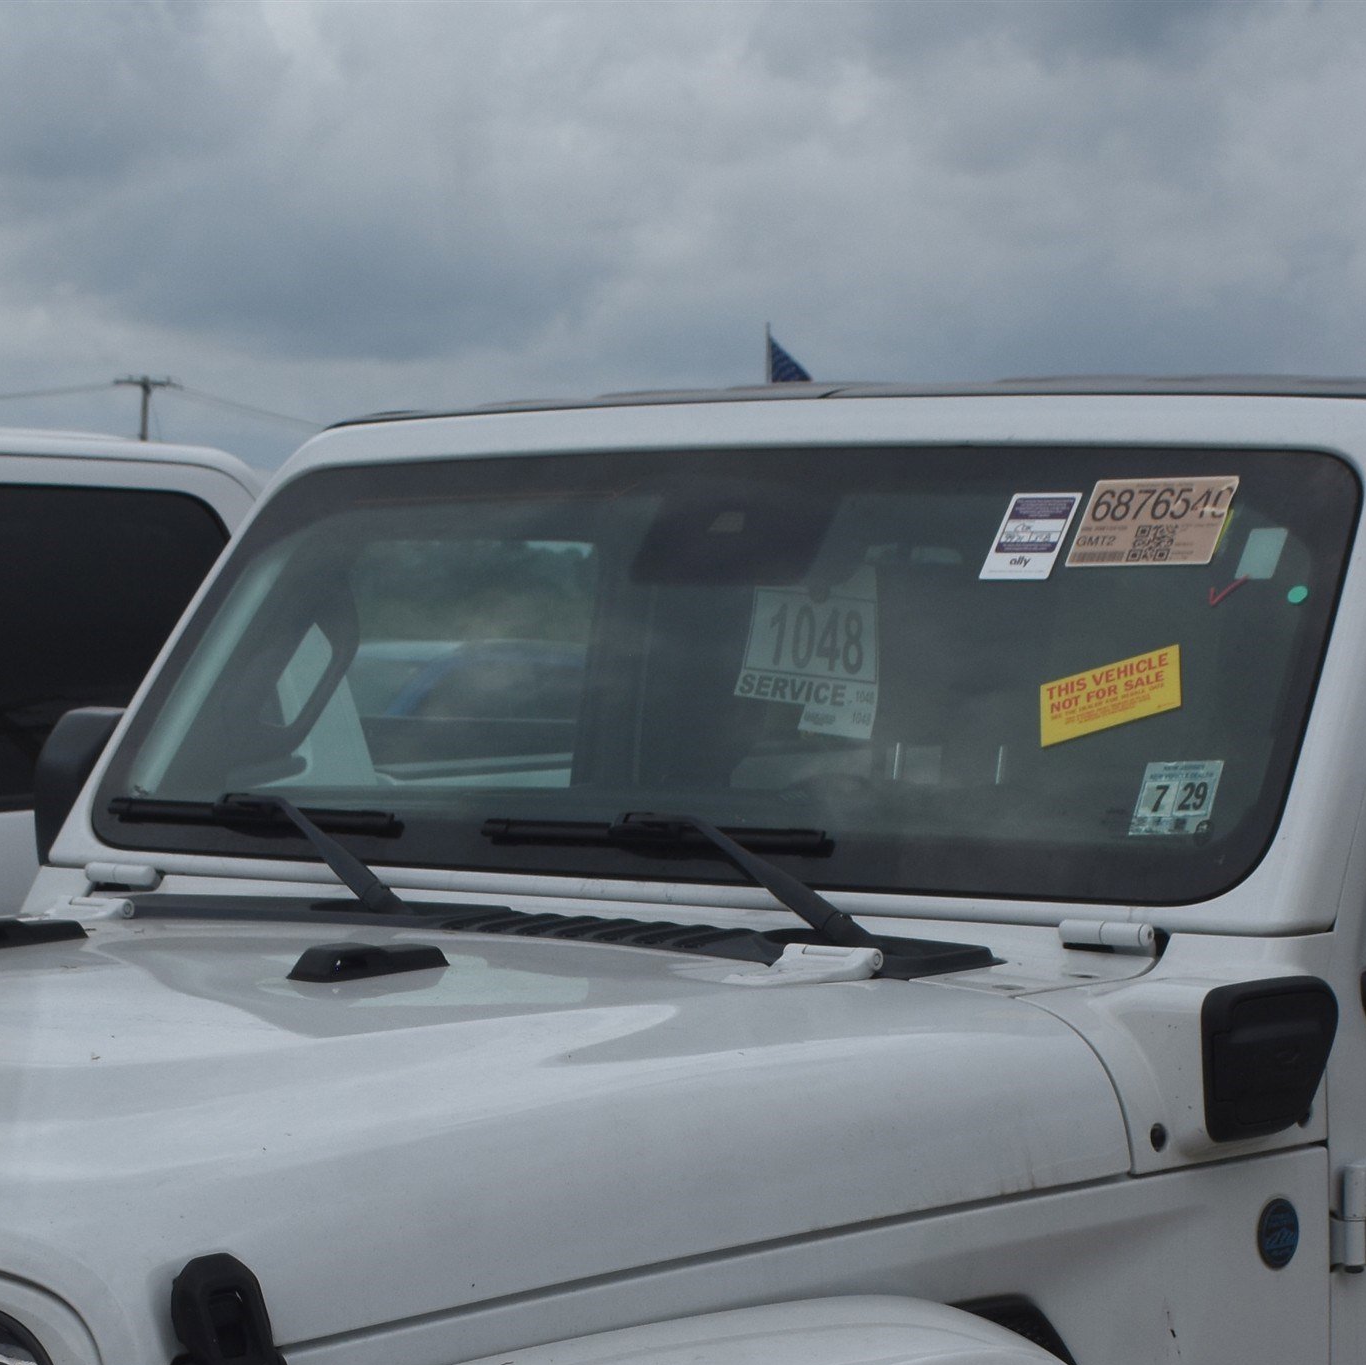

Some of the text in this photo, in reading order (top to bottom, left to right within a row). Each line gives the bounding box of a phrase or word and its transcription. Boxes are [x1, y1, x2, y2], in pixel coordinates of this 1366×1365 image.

[1075, 535, 1116, 547] GMT2
[1009, 556, 1031, 568] ally
[770, 603, 863, 675] 1048
[739, 674, 847, 706] SERVICE
[1047, 652, 1169, 699] THIS VEHICLE
[1050, 695, 1081, 713] NOT
[1086, 684, 1117, 703] FOR
[1124, 670, 1164, 691] SALE
[1151, 781, 1208, 813] 7 29
